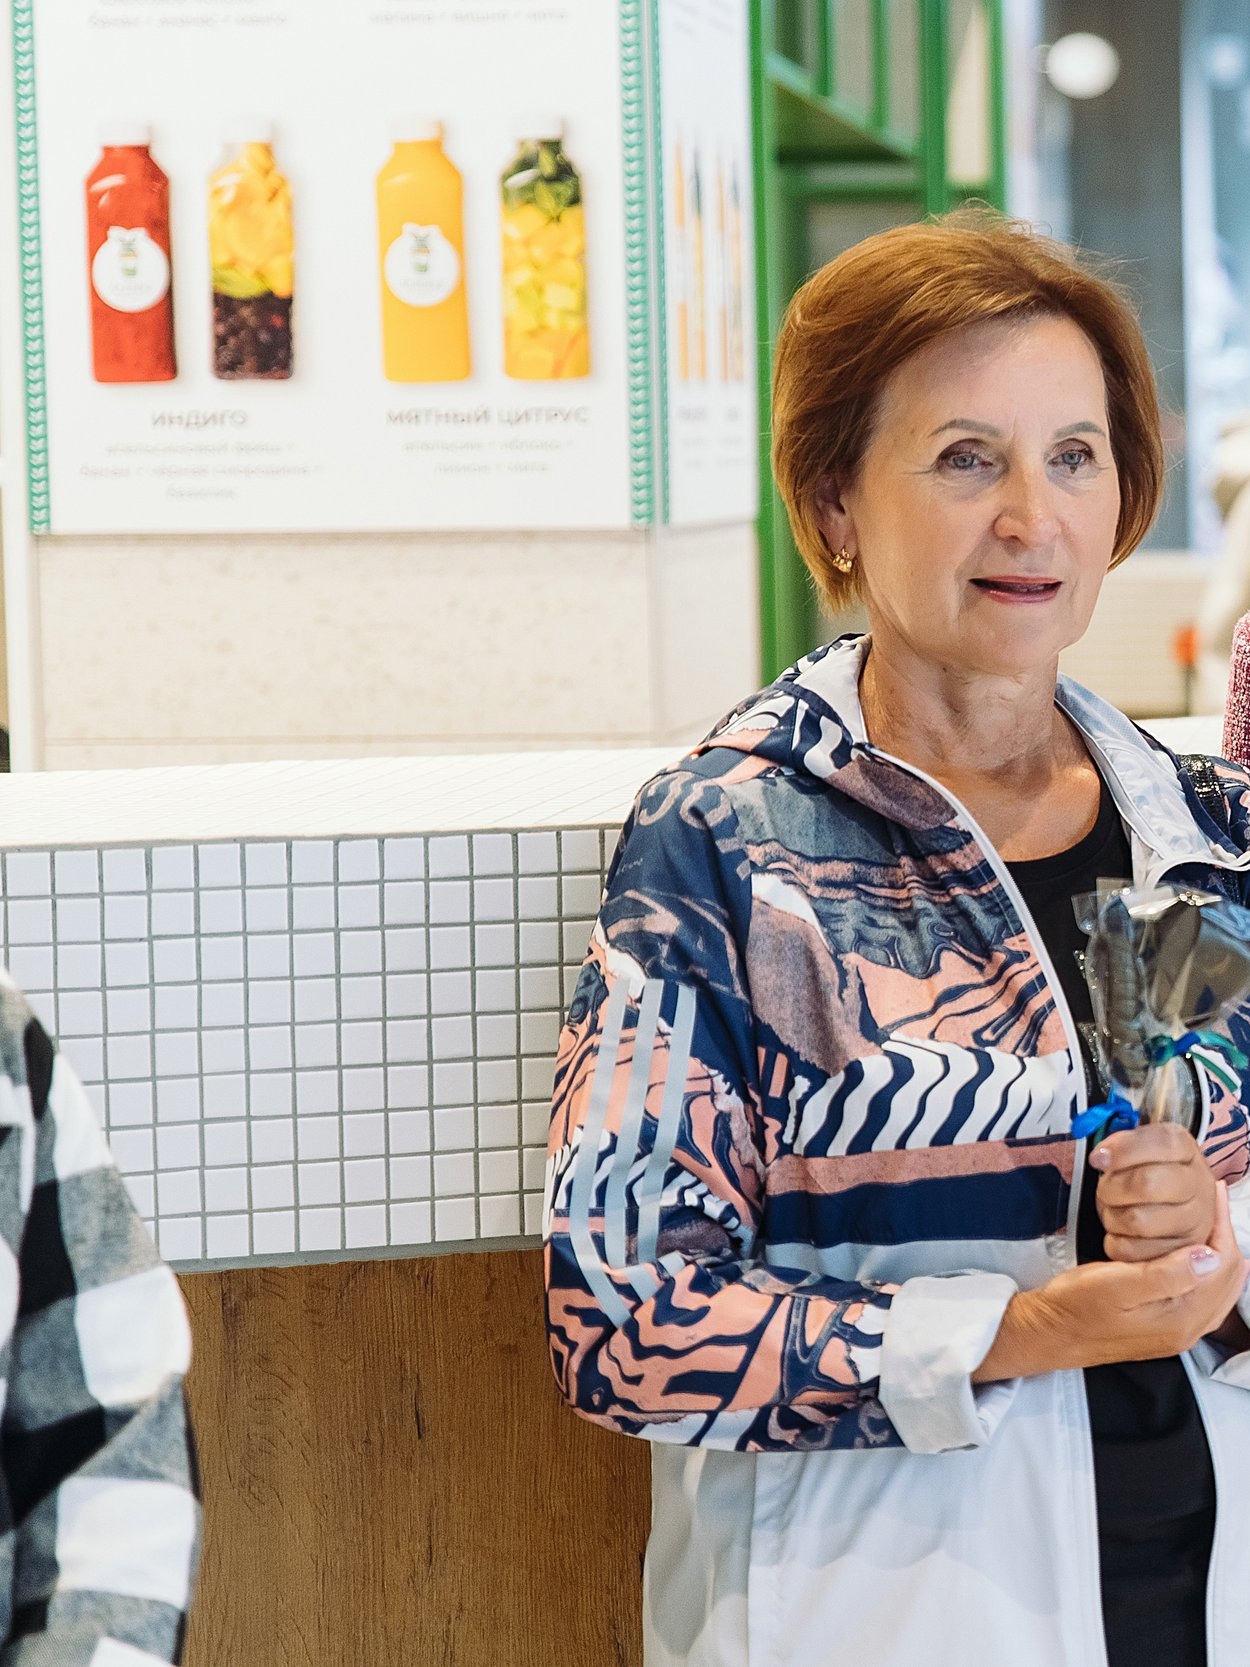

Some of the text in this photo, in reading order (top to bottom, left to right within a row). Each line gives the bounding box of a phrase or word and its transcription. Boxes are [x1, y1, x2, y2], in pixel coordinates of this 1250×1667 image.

[152, 409, 248, 429] ИНДИГО
[387, 404, 591, 427] МЯТНЫЙ ЦИТРУС
